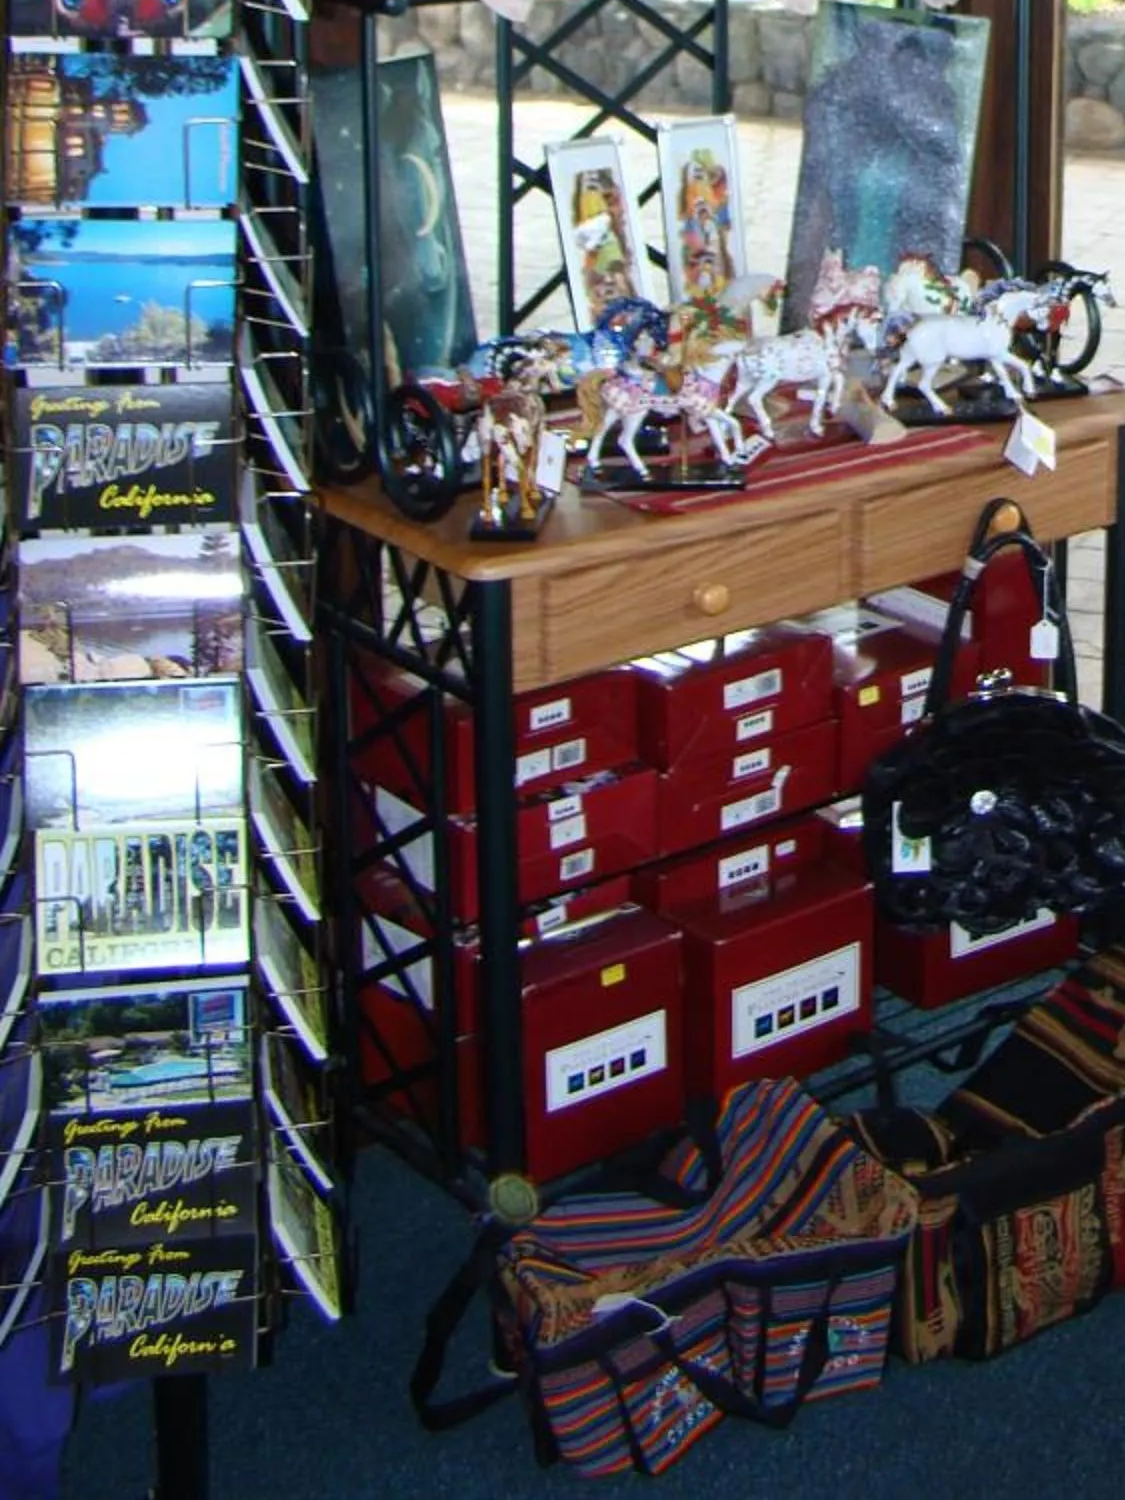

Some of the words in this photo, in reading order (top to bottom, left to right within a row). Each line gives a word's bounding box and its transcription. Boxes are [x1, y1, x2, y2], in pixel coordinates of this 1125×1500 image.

[27, 421, 221, 520] PARADISE
[99, 483, 216, 519] California
[43, 830, 241, 942] PARADISE
[62, 1135, 243, 1241] PARADISE
[130, 1199, 239, 1234] California
[60, 1269, 244, 1372] PARADISE
